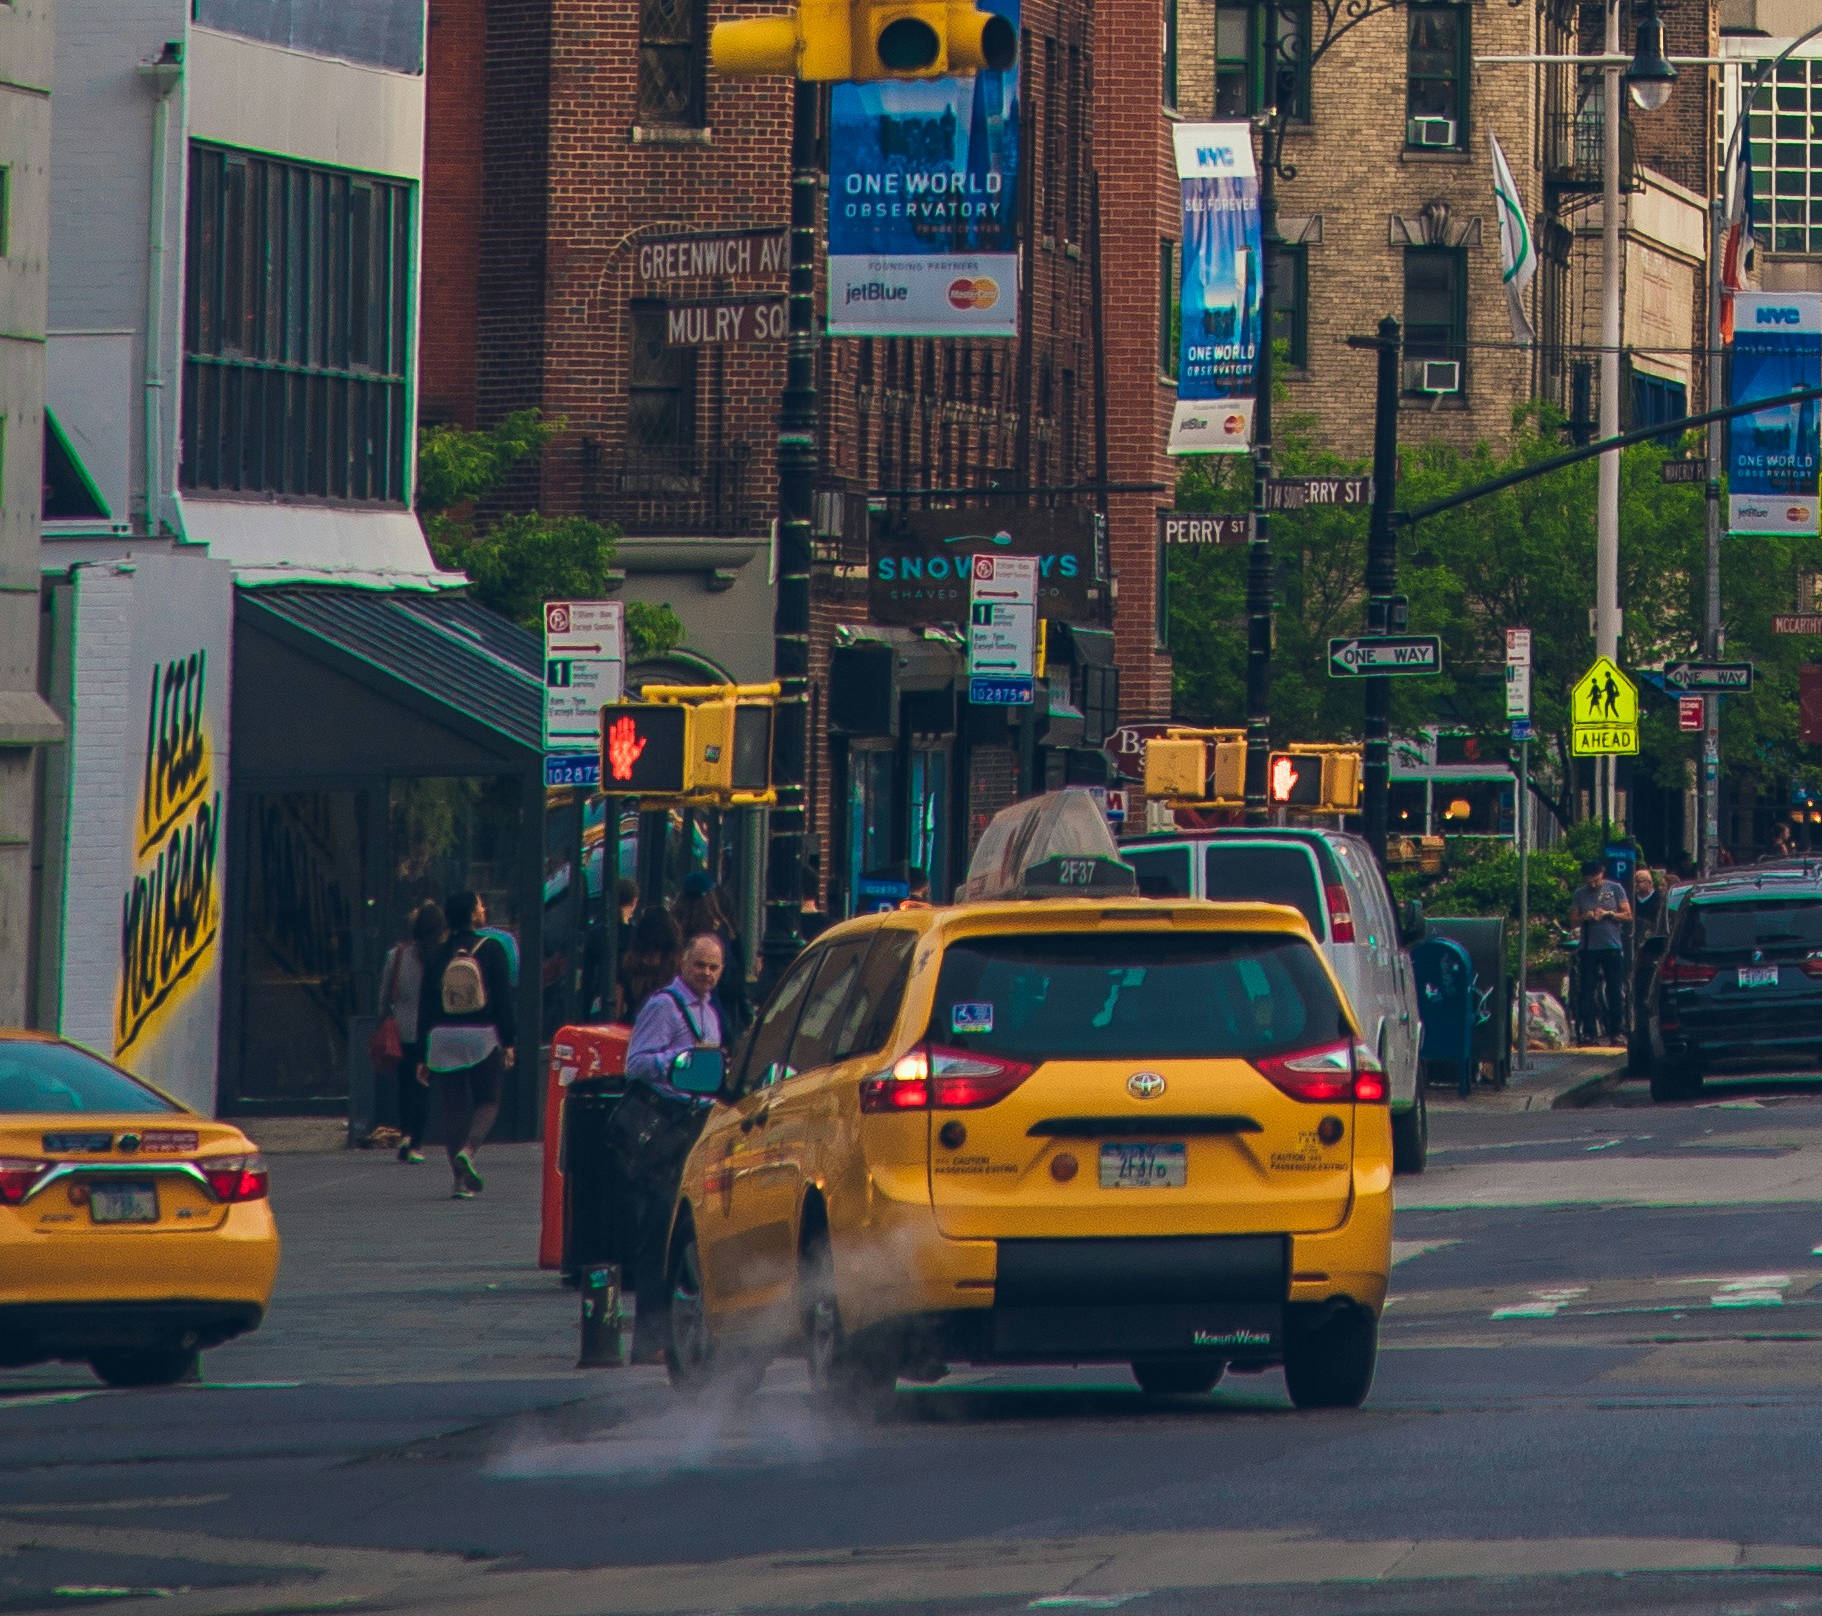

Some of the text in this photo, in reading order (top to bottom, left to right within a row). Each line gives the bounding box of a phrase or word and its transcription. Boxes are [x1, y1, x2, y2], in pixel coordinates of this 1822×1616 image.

[845, 172, 1001, 195] ONE WORLD
[845, 202, 1000, 217] OBSERVATORY
[640, 237, 784, 280] GREENWICH AV
[845, 282, 908, 305] jetBlue
[668, 305, 784, 344] MULRY SQ
[1188, 343, 1255, 361] ONE WORLD
[1187, 364, 1253, 377] OBSERVATORY
[1738, 453, 1813, 467] ONE WORLD
[1345, 481, 1362, 503] ST
[1166, 520, 1245, 544] PERRY ST
[878, 554, 1078, 580] SNOWYS
[890, 589, 957, 599] SHAVED
[1776, 617, 1822, 633] MCCARTHY
[1344, 648, 1429, 665] ONE WAY
[1674, 671, 1745, 684] ONE WAY
[1582, 732, 1631, 748] AHEAD
[1060, 861, 1096, 884] 2F37
[1616, 862, 1627, 879] P
